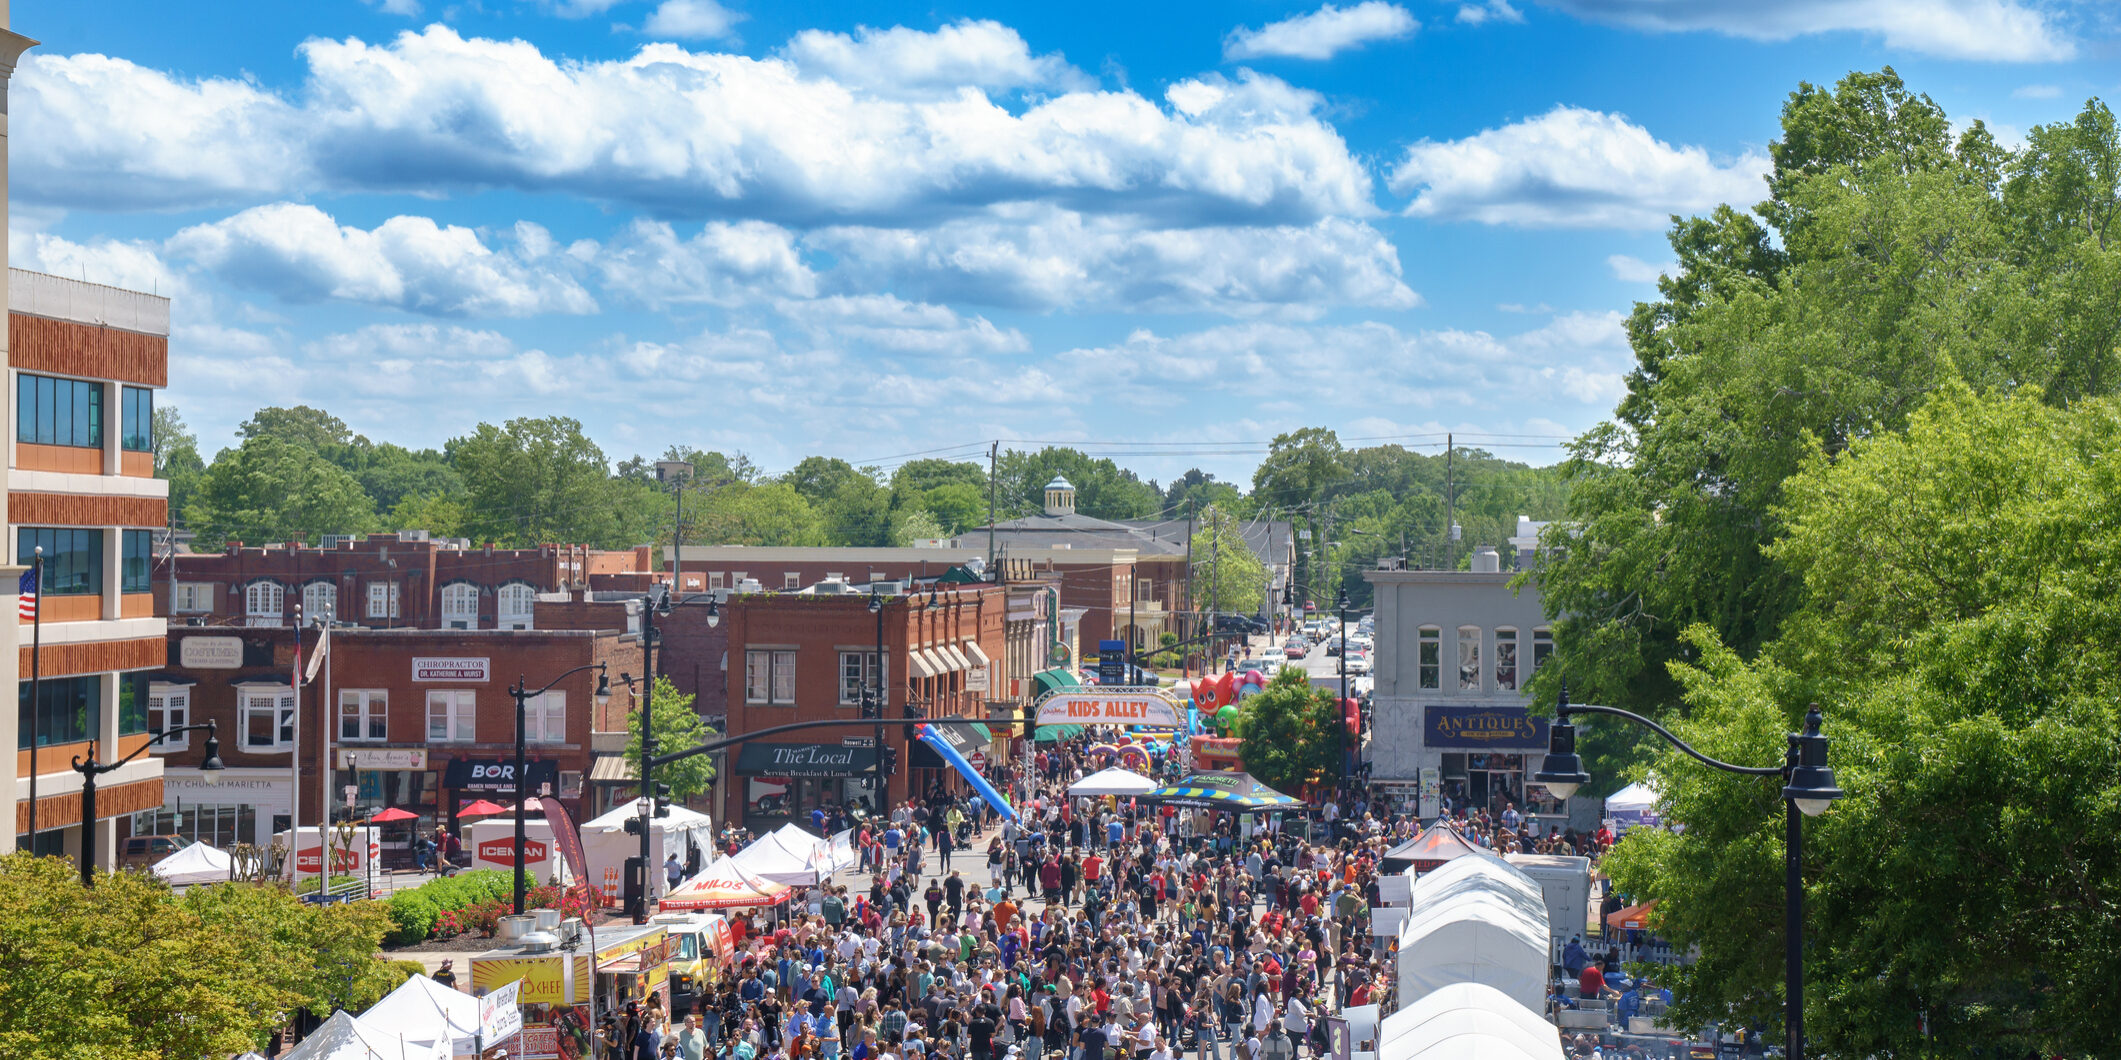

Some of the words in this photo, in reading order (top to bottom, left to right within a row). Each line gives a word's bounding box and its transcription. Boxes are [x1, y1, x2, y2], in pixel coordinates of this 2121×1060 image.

[184, 647, 239, 657] COSTUMES
[417, 660, 484, 668] CHIROPRACTOR
[420, 670, 429, 678] DR.
[429, 670, 457, 678] KATHERINE
[463, 670, 482, 678] WURST
[1067, 701, 1100, 717] KIDS
[1105, 701, 1149, 718] ALLEY
[1437, 715, 1536, 739] ANTIQUES
[773, 748, 805, 764] The
[807, 748, 854, 764] Local
[763, 769, 790, 778] Serving
[790, 769, 822, 777] Breakfast
[227, 780, 272, 788] MARIETTA
[693, 879, 744, 891] MILO'S
[665, 900, 695, 909] Tastes
[697, 899, 717, 907] Like
[719, 897, 769, 906] Homemade
[536, 980, 560, 994] CHEF
